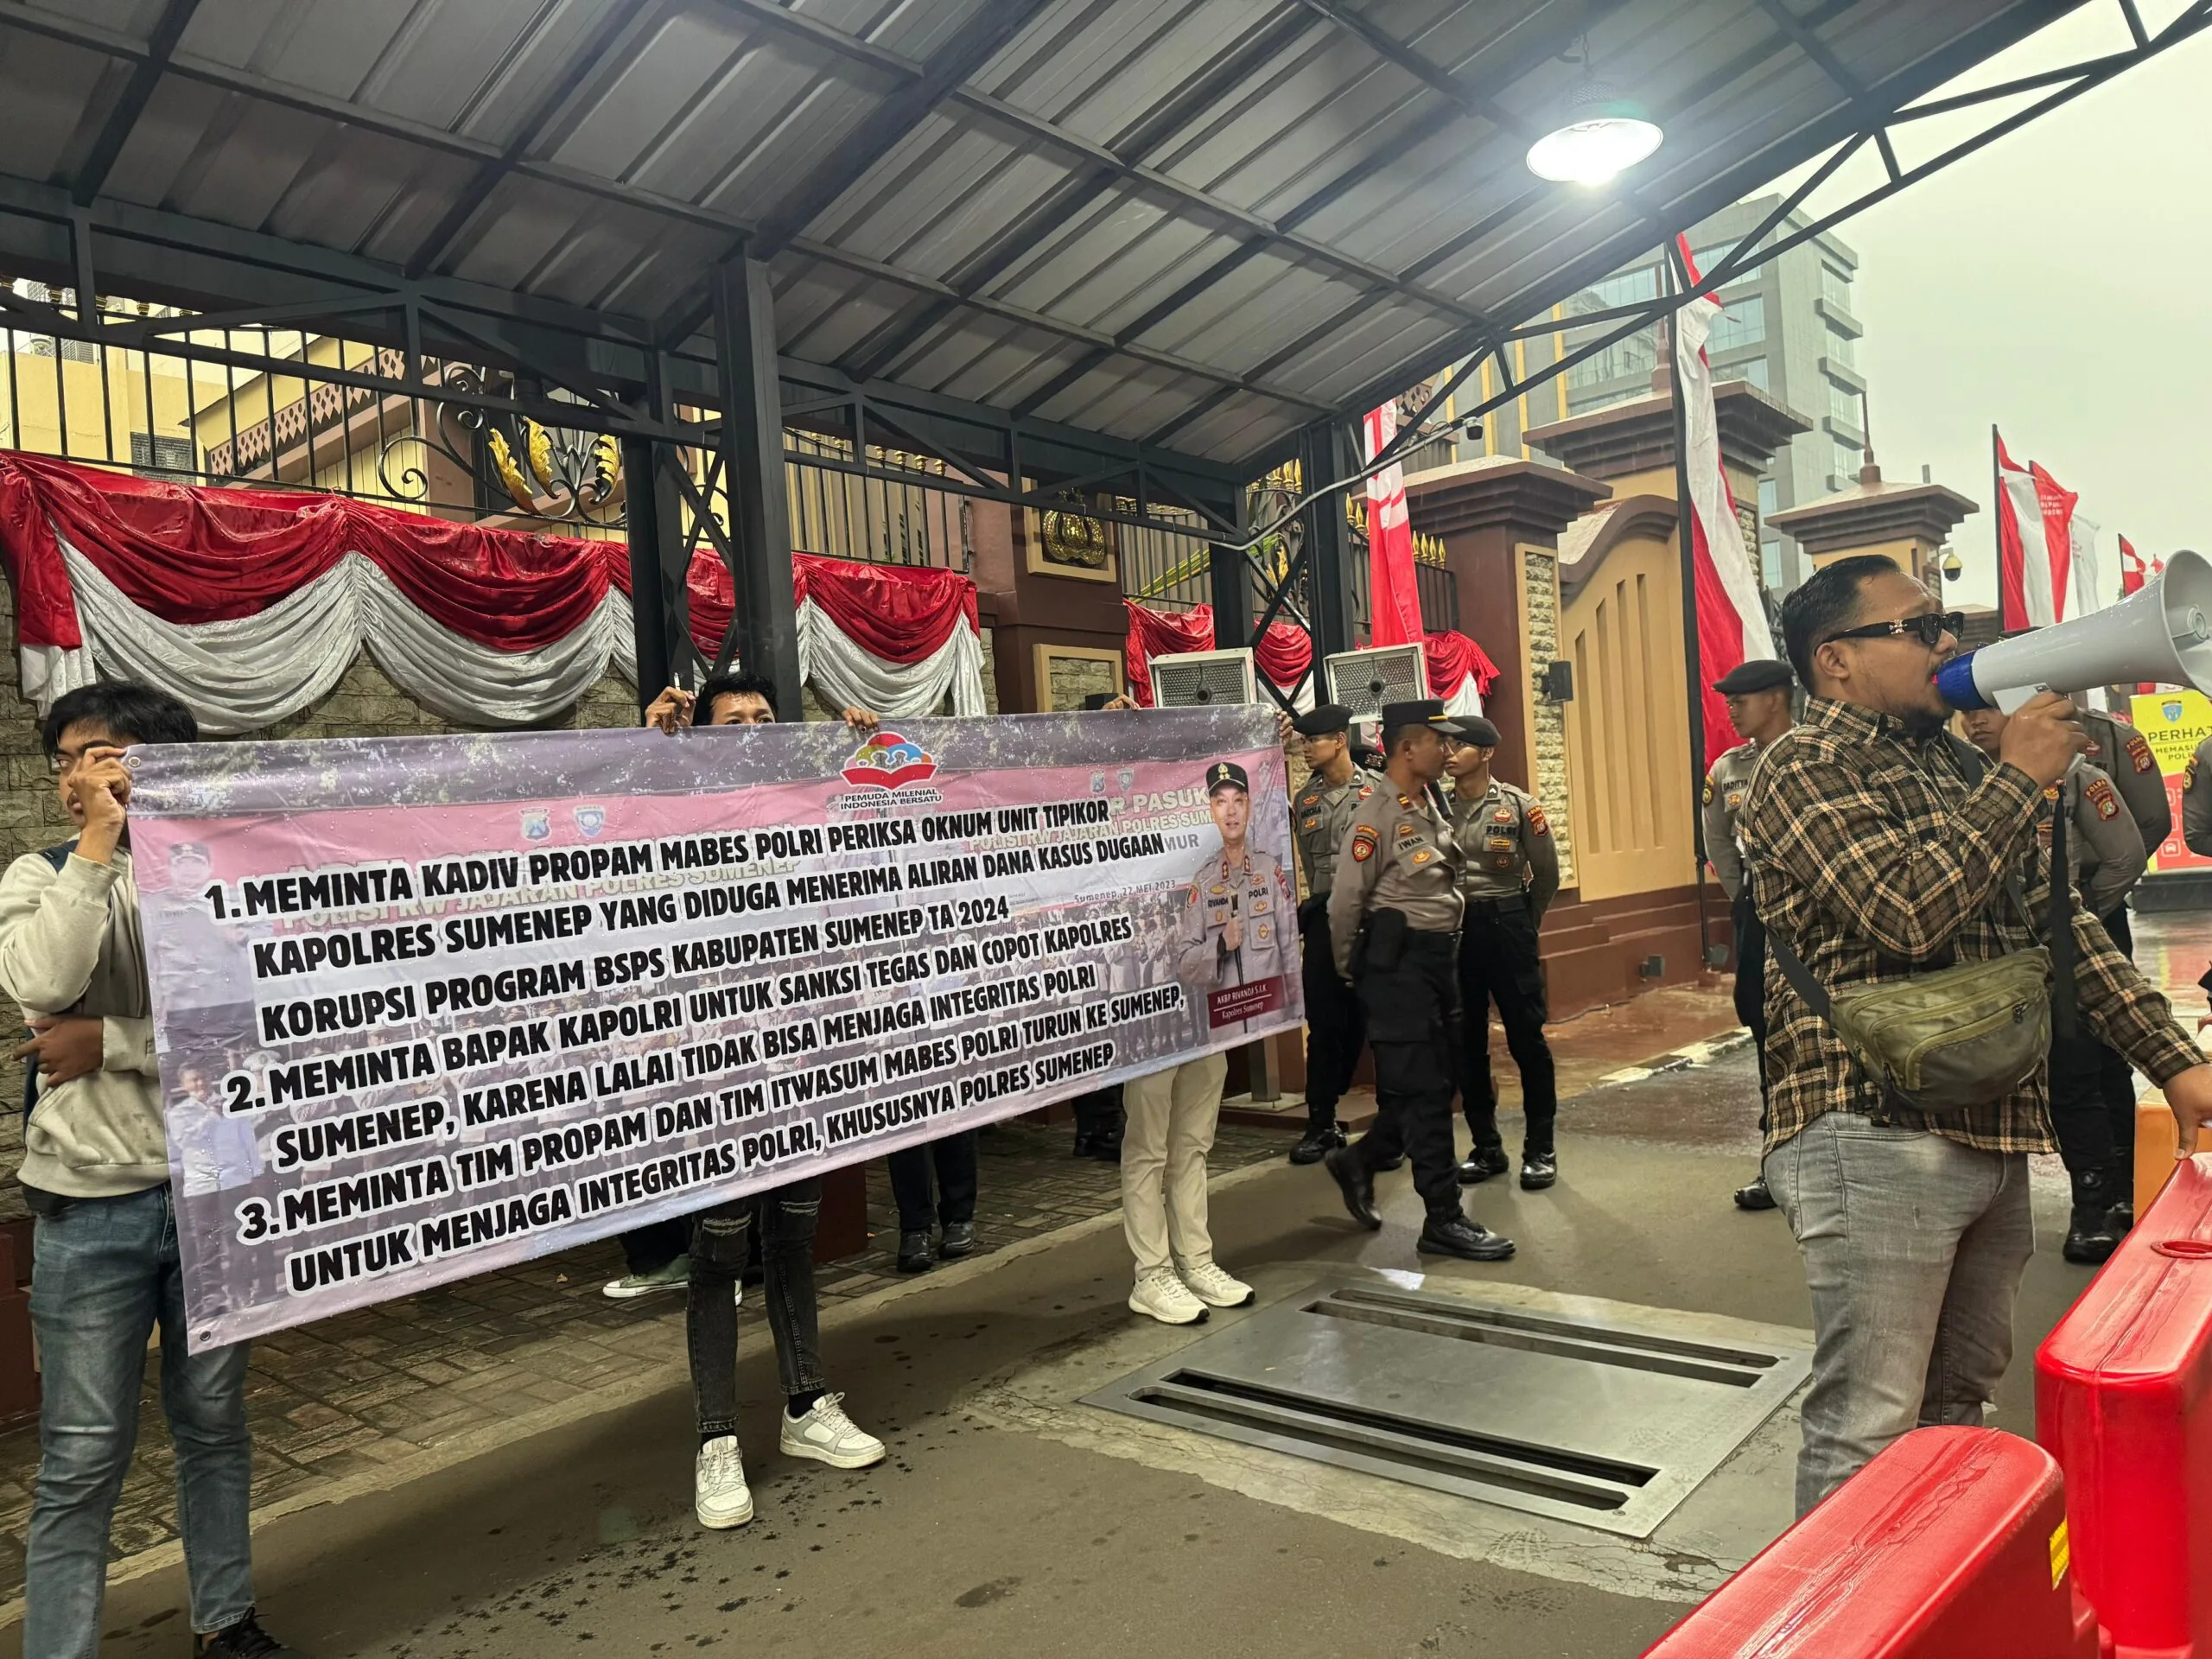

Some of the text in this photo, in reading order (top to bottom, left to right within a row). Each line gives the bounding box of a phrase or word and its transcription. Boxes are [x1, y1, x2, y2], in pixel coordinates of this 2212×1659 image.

[841, 795, 943, 810] INDONESIA BERSATU
[845, 788, 938, 803] PEMUDA MILENIAL
[1123, 815, 1179, 834] POLRES
[422, 857, 518, 896] KADIV
[530, 844, 652, 885] PROPAM
[660, 836, 748, 870] MABES
[756, 827, 823, 861] POLRI
[828, 819, 916, 853] PERIKSA
[922, 811, 992, 843] OKNUM
[998, 807, 1038, 833] UNIT
[1043, 799, 1109, 829] TIPIKOR
[1398, 836, 1424, 851] IWAN
[254, 834, 1165, 978] KAPOLRES SUMENEP YANG DIDUGA MENERIMA ALIRAN DANA KASUS DUGAAN
[1249, 887, 1268, 899] POLRI
[262, 897, 1009, 1040] KORUPSI PROGRAM BSPS KABUPATEN SUMENEP TA 2024
[442, 1021, 550, 1071] BAPAK
[559, 998, 682, 1048] KAPOLRI
[690, 982, 773, 1022] UNTUK
[780, 966, 861, 1005] SANKSI
[867, 952, 931, 988] TEGAS
[935, 945, 978, 976] DAN
[982, 933, 1039, 965] COPOT
[1045, 917, 1132, 954] KAPOLRES
[1217, 993, 1231, 1005] AKBP
[1222, 1001, 1264, 1020] Kapolres Sumenep
[277, 964, 1096, 1166] SUMENEP, KARENA LALAI TIDAK BISA MENJAGA INTEGRITAS POLRI
[456, 1145, 513, 1185] TIM
[523, 1112, 646, 1171] PROPAM
[656, 1097, 712, 1137] DAN
[720, 1084, 764, 1120] TIM
[772, 1058, 878, 1108] ITWASUM
[885, 1039, 957, 1079] MABES
[962, 1026, 1019, 1061] POLRI
[1022, 1010, 1082, 1045] TURUN
[1086, 1004, 1108, 1030] KE
[1111, 986, 1185, 1021] SUMENEP,
[291, 1043, 1114, 1291] UNTUK MENJAGA INTEGRITAS POLRI, KHUSUSNYA POLRES SUMENEP
